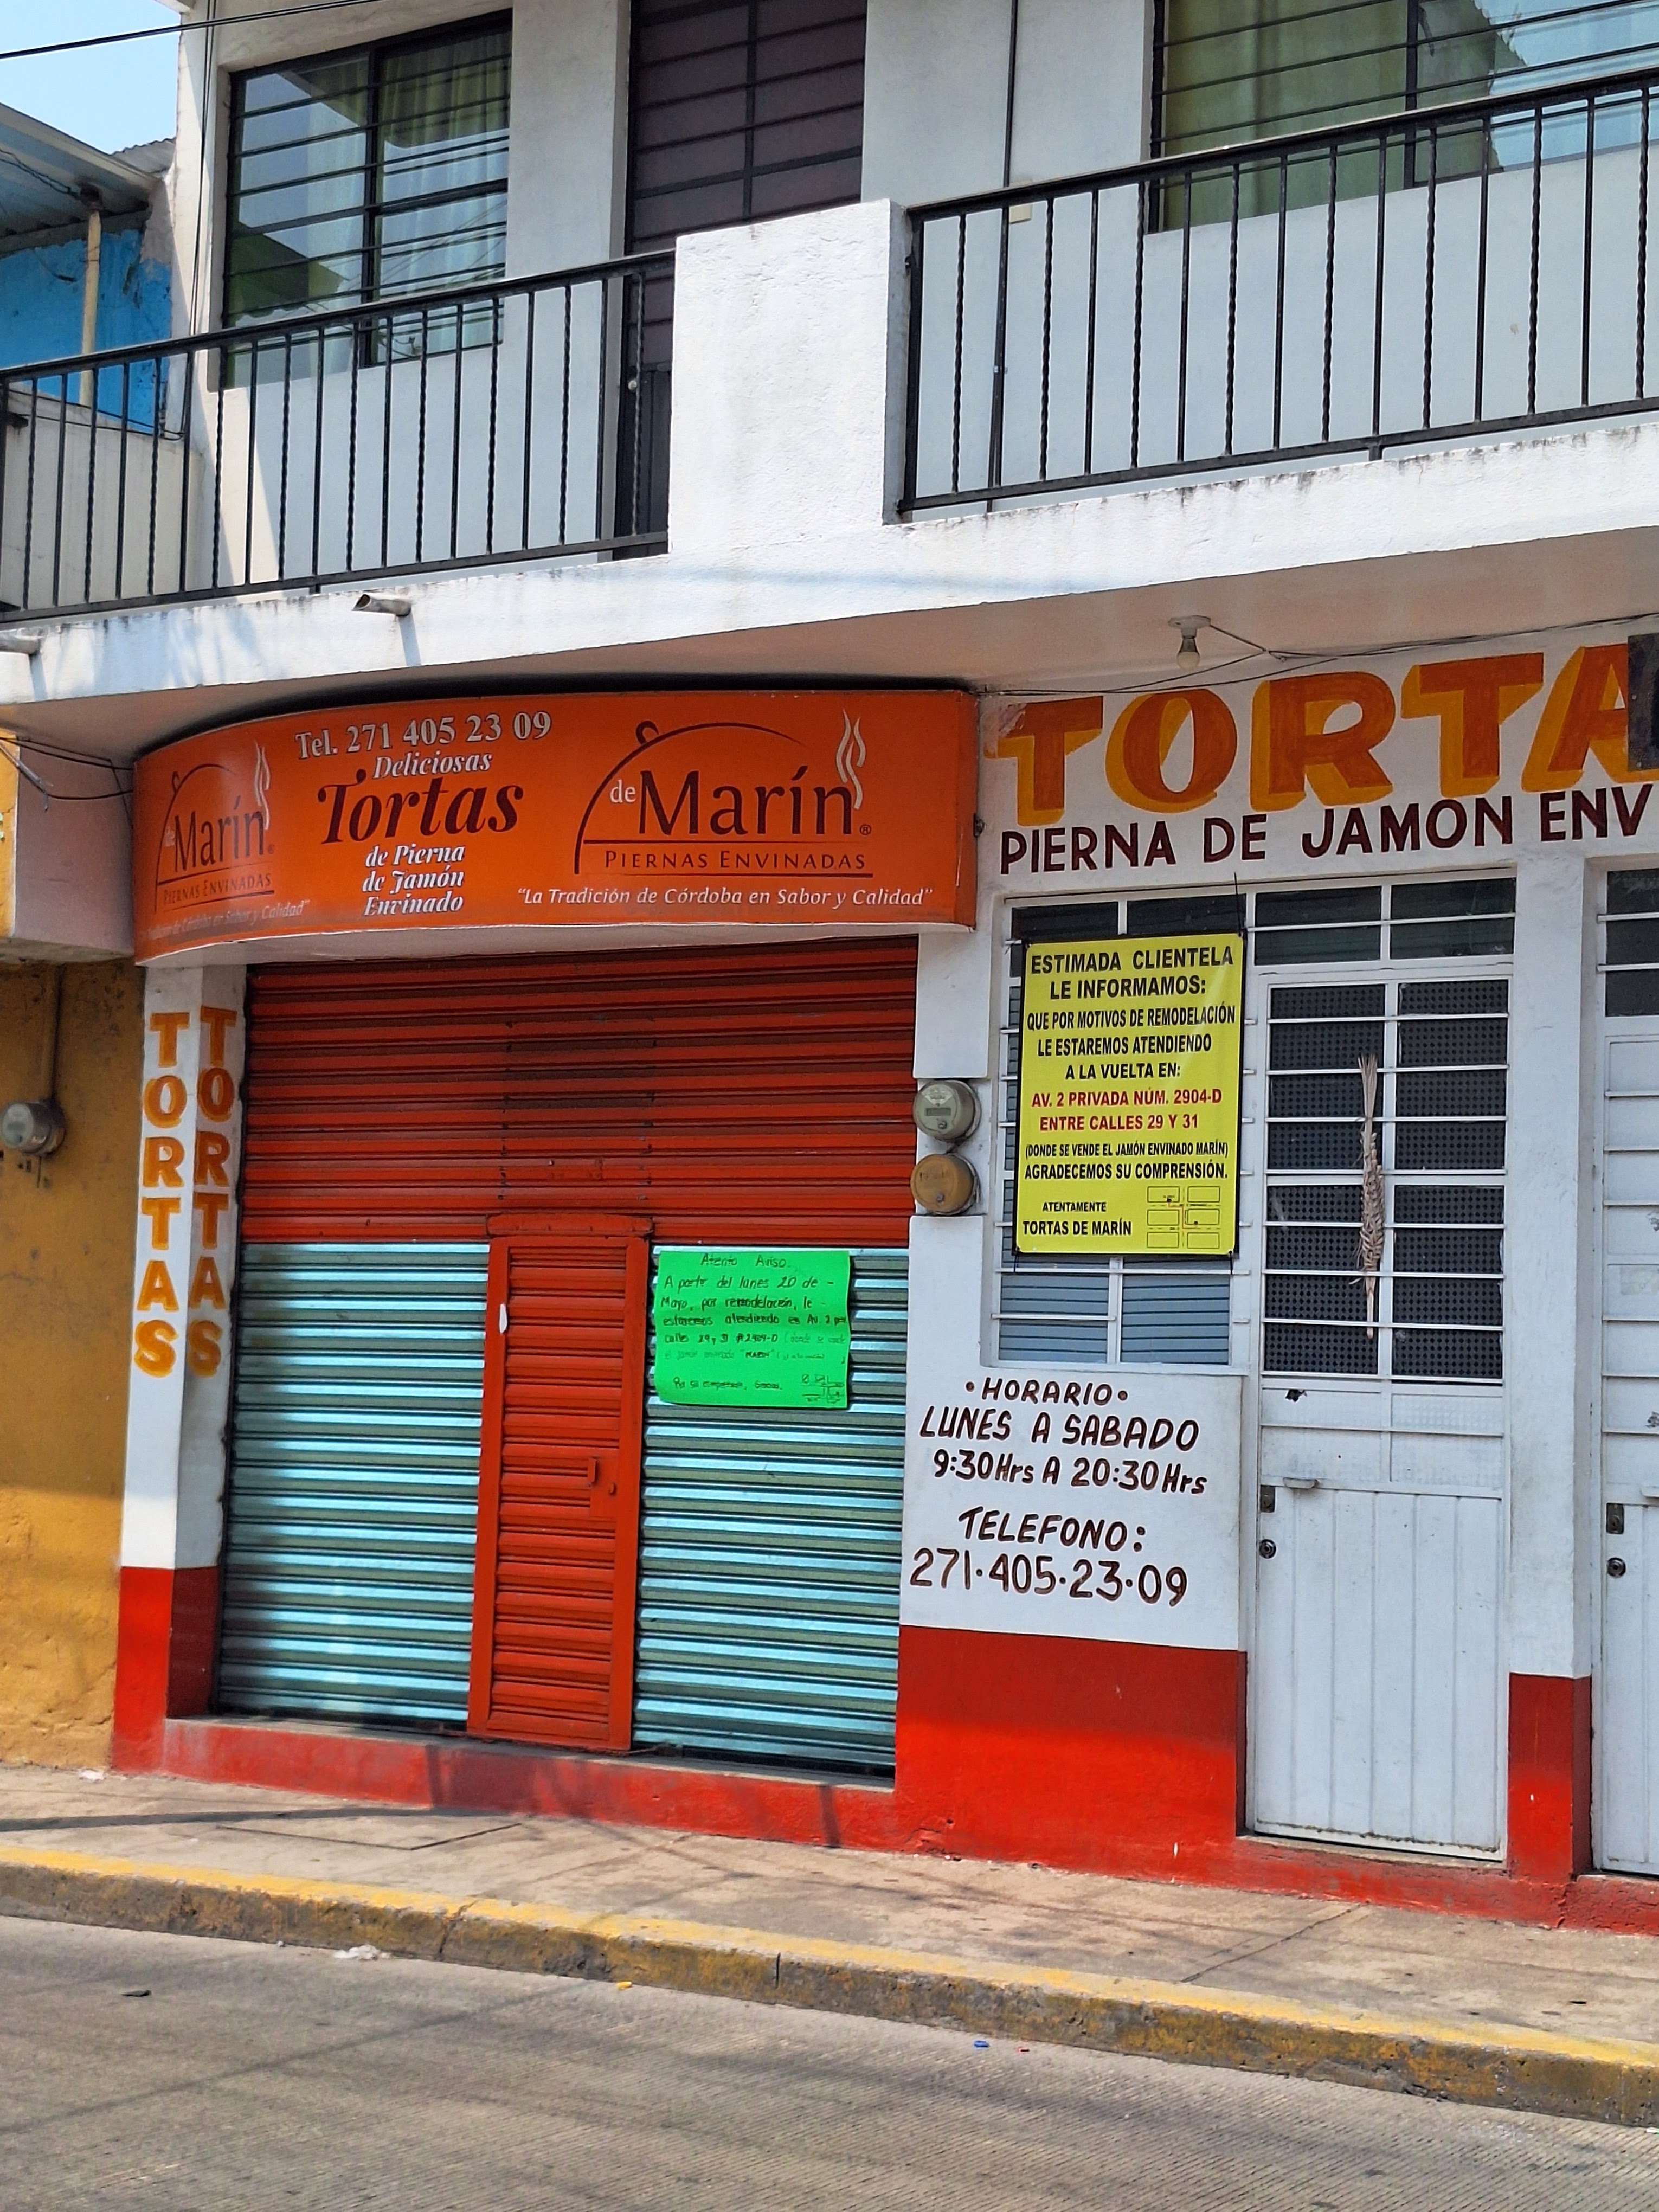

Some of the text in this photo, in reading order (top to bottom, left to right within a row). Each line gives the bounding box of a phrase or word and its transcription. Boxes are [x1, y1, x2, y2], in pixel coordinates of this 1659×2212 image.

[294, 710, 552, 760] Tel. 271 405 23 09
[372, 751, 493, 780] Deliciosas
[317, 769, 524, 846] Tortas
[609, 765, 852, 836] de Marín
[175, 795, 264, 873] Marín
[1000, 783, 1654, 875] PIERNA DE JAMON ENV
[365, 843, 465, 868] de Pierna
[605, 850, 865, 869] PIERNAS ENVINADAS
[203, 873, 271, 897] ENVINADAS
[362, 864, 465, 893] de Jamón
[363, 890, 464, 917] Envinado
[549, 886, 631, 905] Tradición
[636, 888, 658, 904] de
[664, 886, 742, 905] Córdoba
[748, 892, 770, 905] en
[777, 888, 832, 905] Sabor
[832, 894, 846, 910] y
[1032, 946, 1233, 974] ESTIMADA CLIENTELA
[1050, 975, 1206, 999] LE INFORMAMOS:
[1027, 1001, 1235, 1031] QUE POR MOTIVOS DE REMODELACIÓN
[1038, 1033, 1212, 1057] LE ESTAREMOS ATENDIENDO
[1065, 1062, 1181, 1079] A LA VUELTA EN:
[1032, 1086, 1222, 1107] AV. 2 PRIVADA NÚM. 2904-D
[1040, 1114, 1198, 1131] ENTRE CALLES 29 Y 31
[1025, 1139, 1229, 1159] (DONDE SE VENDE EL JAMÓN ENVINADO MARÍN)
[1025, 1160, 1228, 1179] AGRADECEMOS SU COMPRENSIÓN.
[133, 1012, 190, 1377] TORTAS
[187, 1005, 237, 1378] TORTAS
[1042, 1201, 1107, 1212] ATENTAMENTE
[1023, 1218, 1131, 1236] TORTAS DE MARÍN
[664, 1275, 673, 1289] A
[716, 1275, 733, 1288] del
[739, 1276, 769, 1289] lunes
[776, 1276, 797, 1288] 20
[802, 1276, 818, 1288] de
[920, 1405, 1199, 1451] LUNES A SABADO
[1042, 1455, 1060, 1485] A
